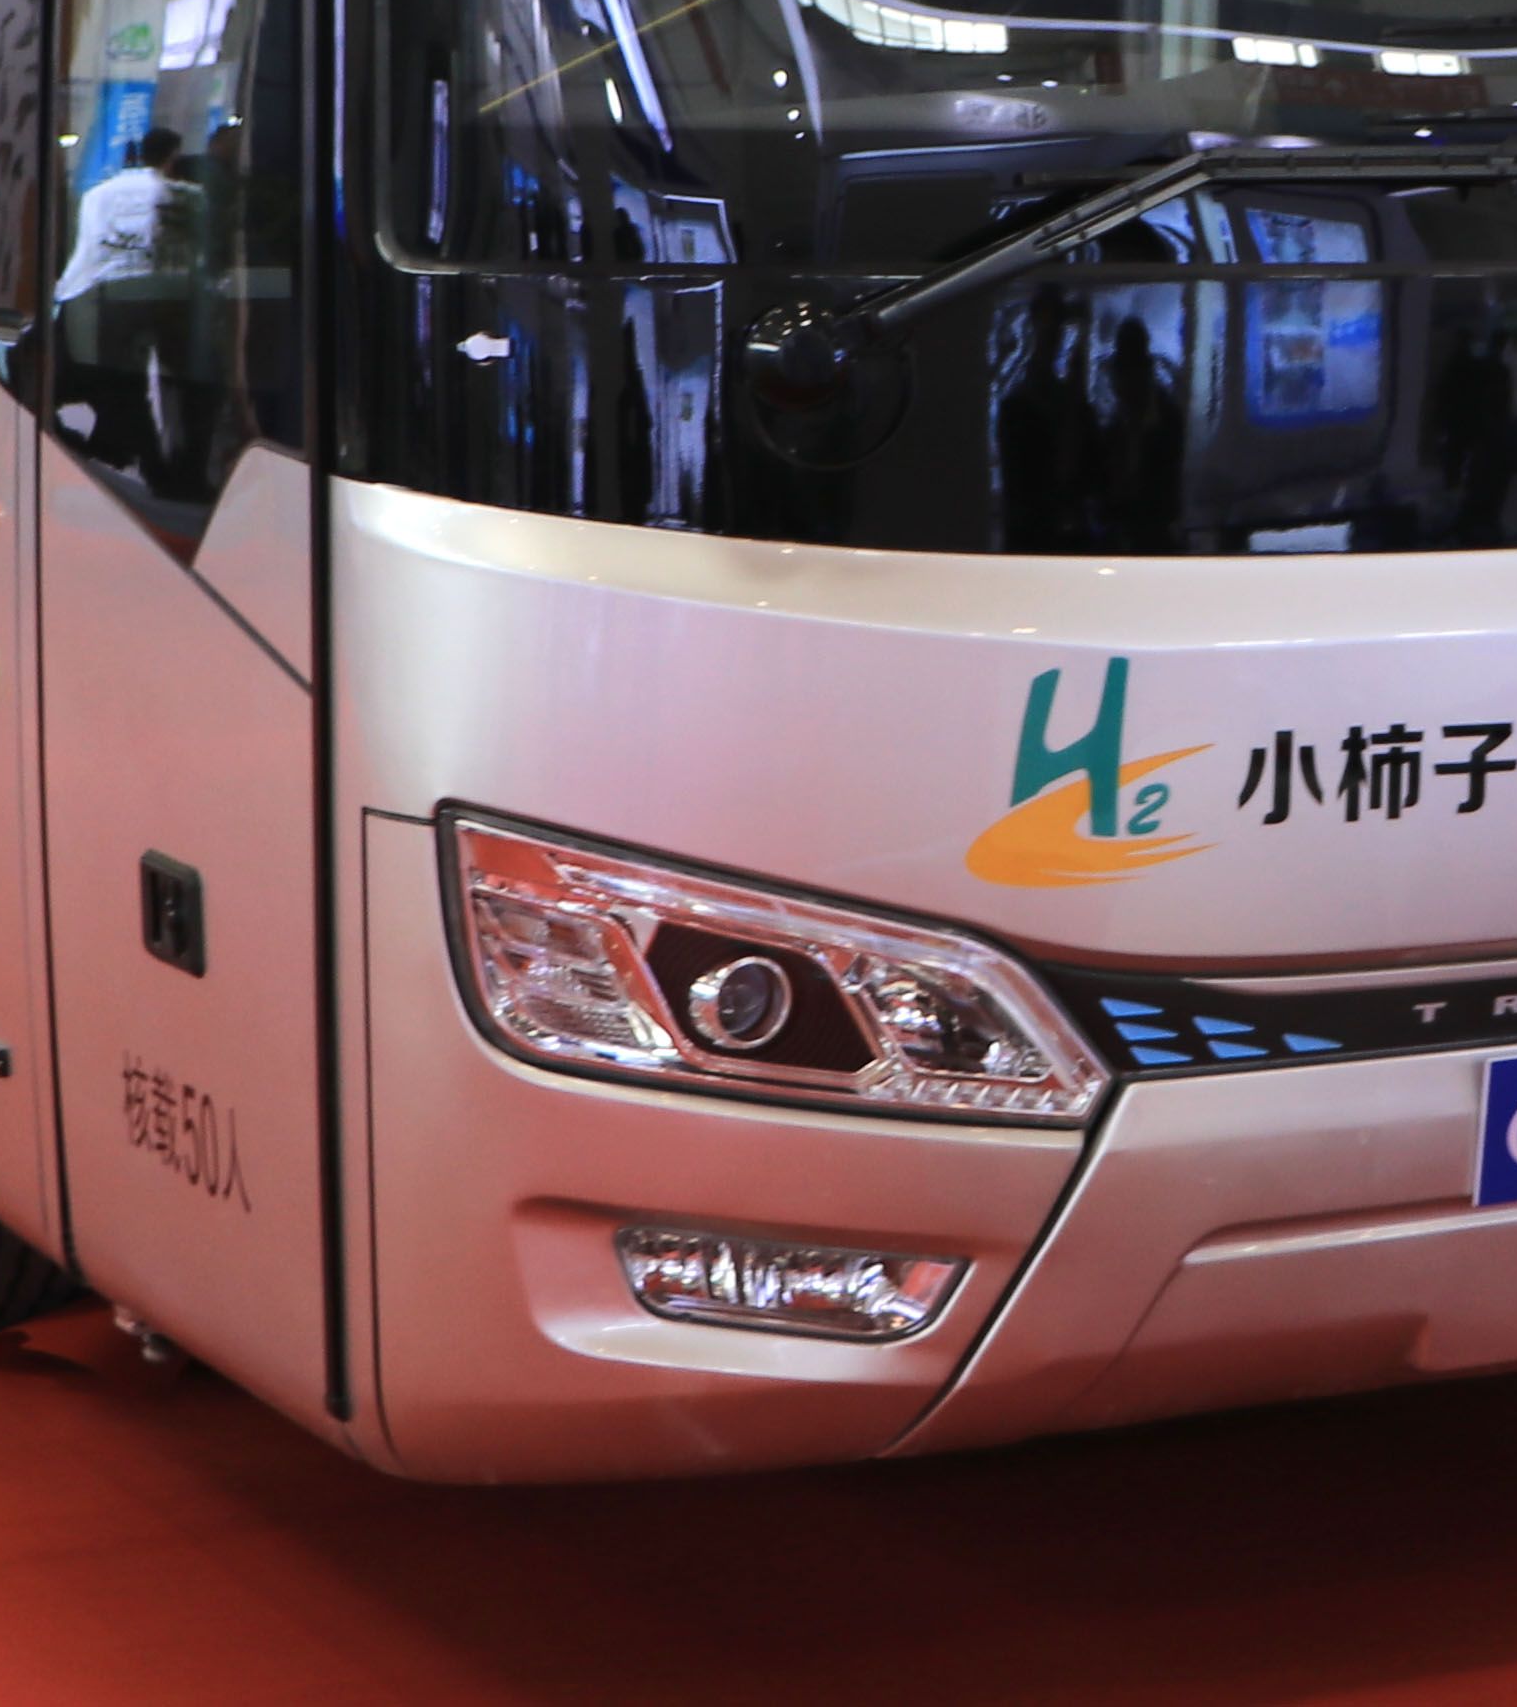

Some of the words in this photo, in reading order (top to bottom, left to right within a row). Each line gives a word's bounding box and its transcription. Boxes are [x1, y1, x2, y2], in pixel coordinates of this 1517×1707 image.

[1238, 722, 1517, 824] 小柿子
[123, 1052, 251, 1213] 核载50人
